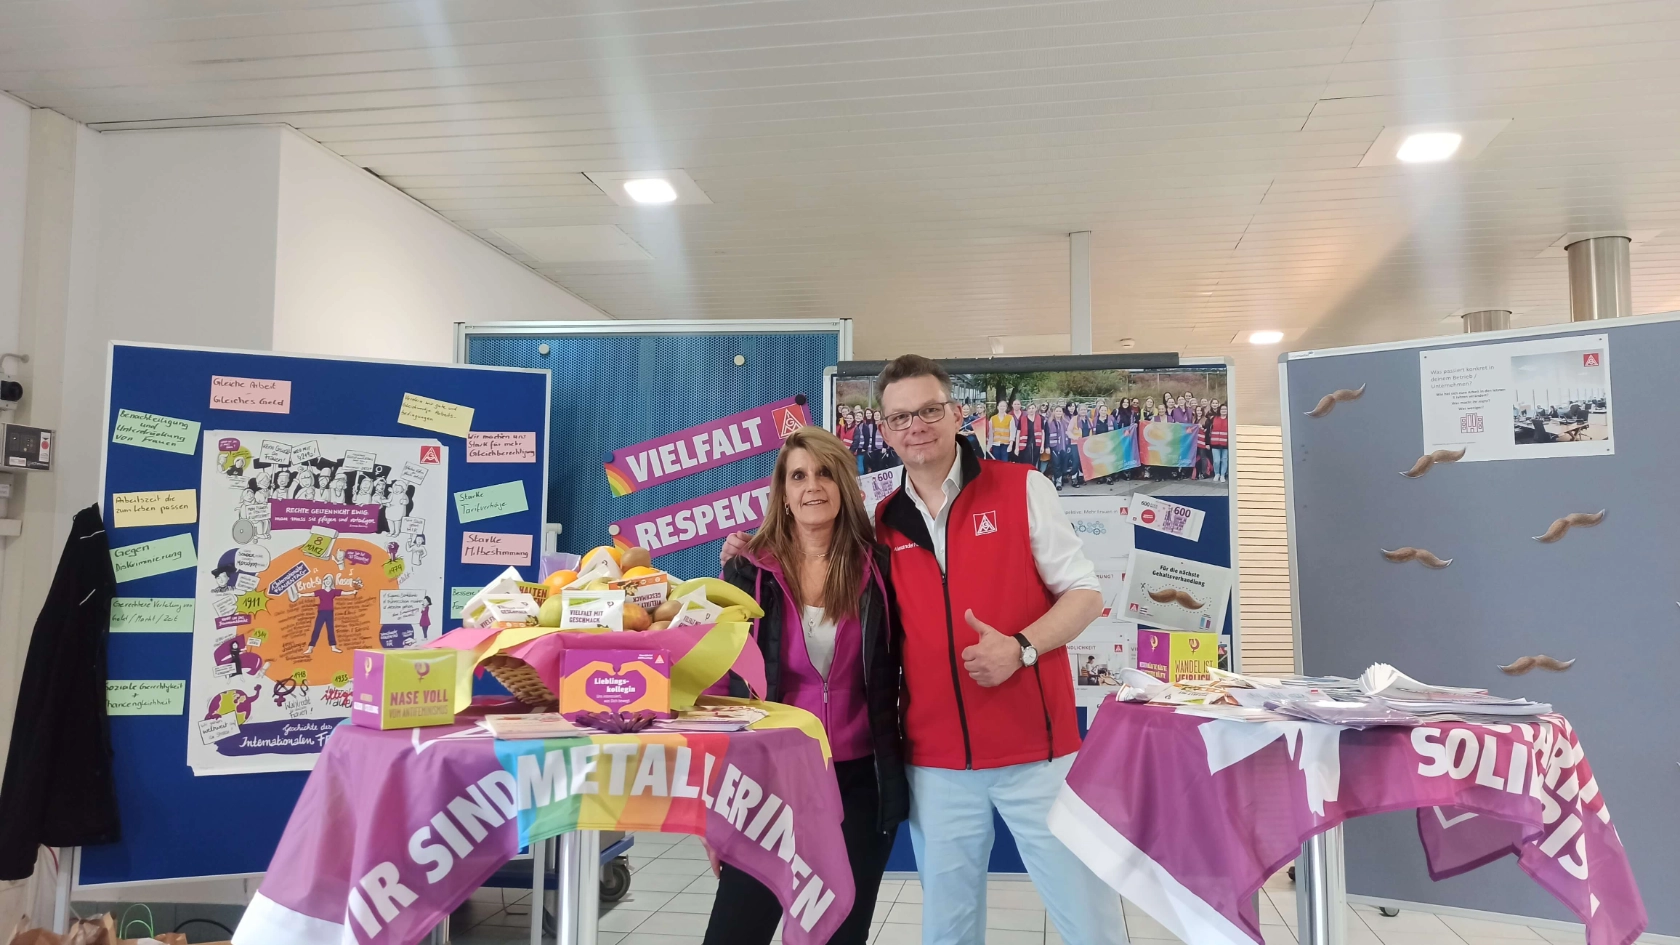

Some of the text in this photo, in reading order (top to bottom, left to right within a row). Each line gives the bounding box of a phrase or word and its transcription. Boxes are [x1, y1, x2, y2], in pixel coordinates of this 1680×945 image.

[213, 378, 277, 390] Gleiche Arbeit
[1431, 381, 1472, 389] Unternehmen?
[213, 396, 285, 406] Gleiches Geld
[120, 410, 189, 430] Benachteiligung
[140, 422, 159, 430] und
[115, 434, 177, 447] von Frauen
[490, 441, 501, 449] für
[469, 449, 535, 458] Gleichberechtigung
[626, 417, 762, 483] VIELFALT
[878, 471, 894, 482] 600
[116, 494, 176, 504] Arbeitszeit die
[460, 492, 484, 501] Starke
[160, 504, 189, 514] passen
[461, 502, 506, 514] Tarifverträge
[1174, 506, 1191, 518] 600
[635, 486, 771, 551] RESPEKT
[314, 537, 323, 545] 8
[467, 534, 502, 543] Starke
[114, 544, 150, 558] Gegen
[465, 546, 528, 558] Mitbestimmung
[115, 550, 182, 572] Diskriminierung
[1152, 570, 1205, 587] Gehaltsverhandlung
[1179, 570, 1200, 578] nächste
[297, 578, 316, 591] Brot
[336, 573, 353, 587] Rosen
[243, 597, 260, 608] 1911
[633, 592, 661, 602] GESCHMACK
[1175, 660, 1201, 673] WANDEL
[1204, 660, 1213, 671] IST
[594, 678, 629, 686] Lieblings-
[606, 686, 635, 694] kollegin
[107, 698, 172, 709] hancengleichheit
[390, 691, 419, 706] NASE
[423, 689, 448, 703] VOLL
[389, 705, 448, 718] VOM ANTIFEMINISMUS
[283, 723, 318, 735] Geschichte
[240, 734, 315, 747] Internationalen
[348, 861, 419, 939] IR
[408, 770, 518, 884] SIND
